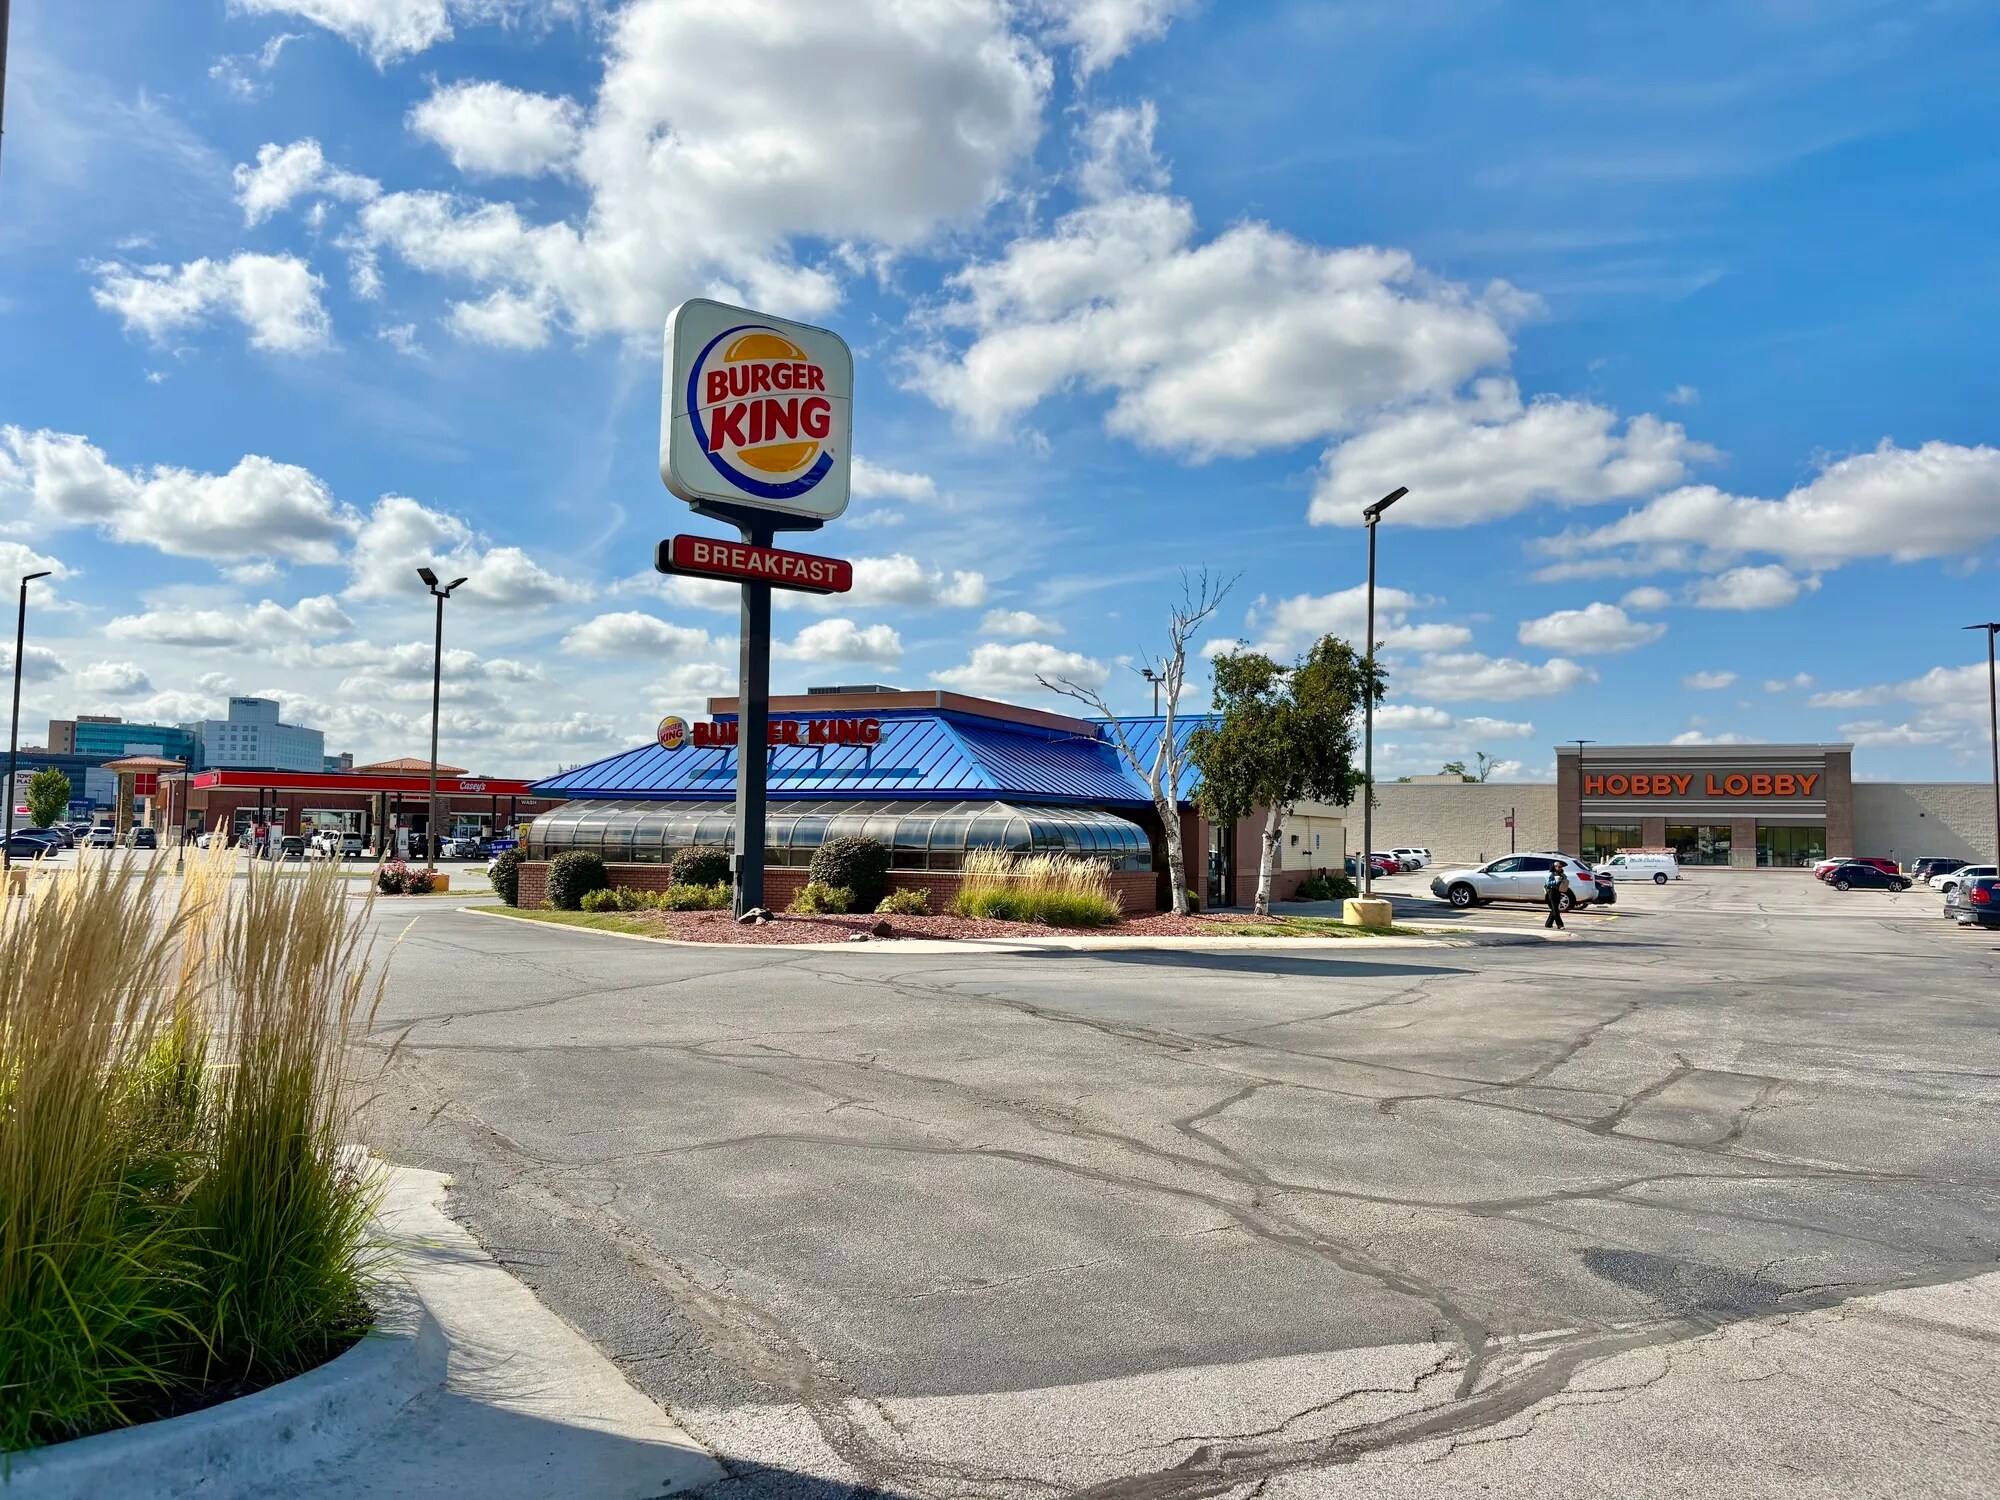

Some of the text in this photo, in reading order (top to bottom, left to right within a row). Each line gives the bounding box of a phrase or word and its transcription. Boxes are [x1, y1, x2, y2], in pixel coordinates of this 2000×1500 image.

[706, 362, 826, 404] BURGER
[708, 397, 831, 452] KING
[693, 542, 838, 583] BREAKFAST
[660, 722, 683, 735] BURGER
[660, 729, 683, 744] KING
[808, 718, 881, 745] KING
[460, 781, 486, 792] Casey's
[1584, 774, 1818, 796] HOBBY LOBBY
